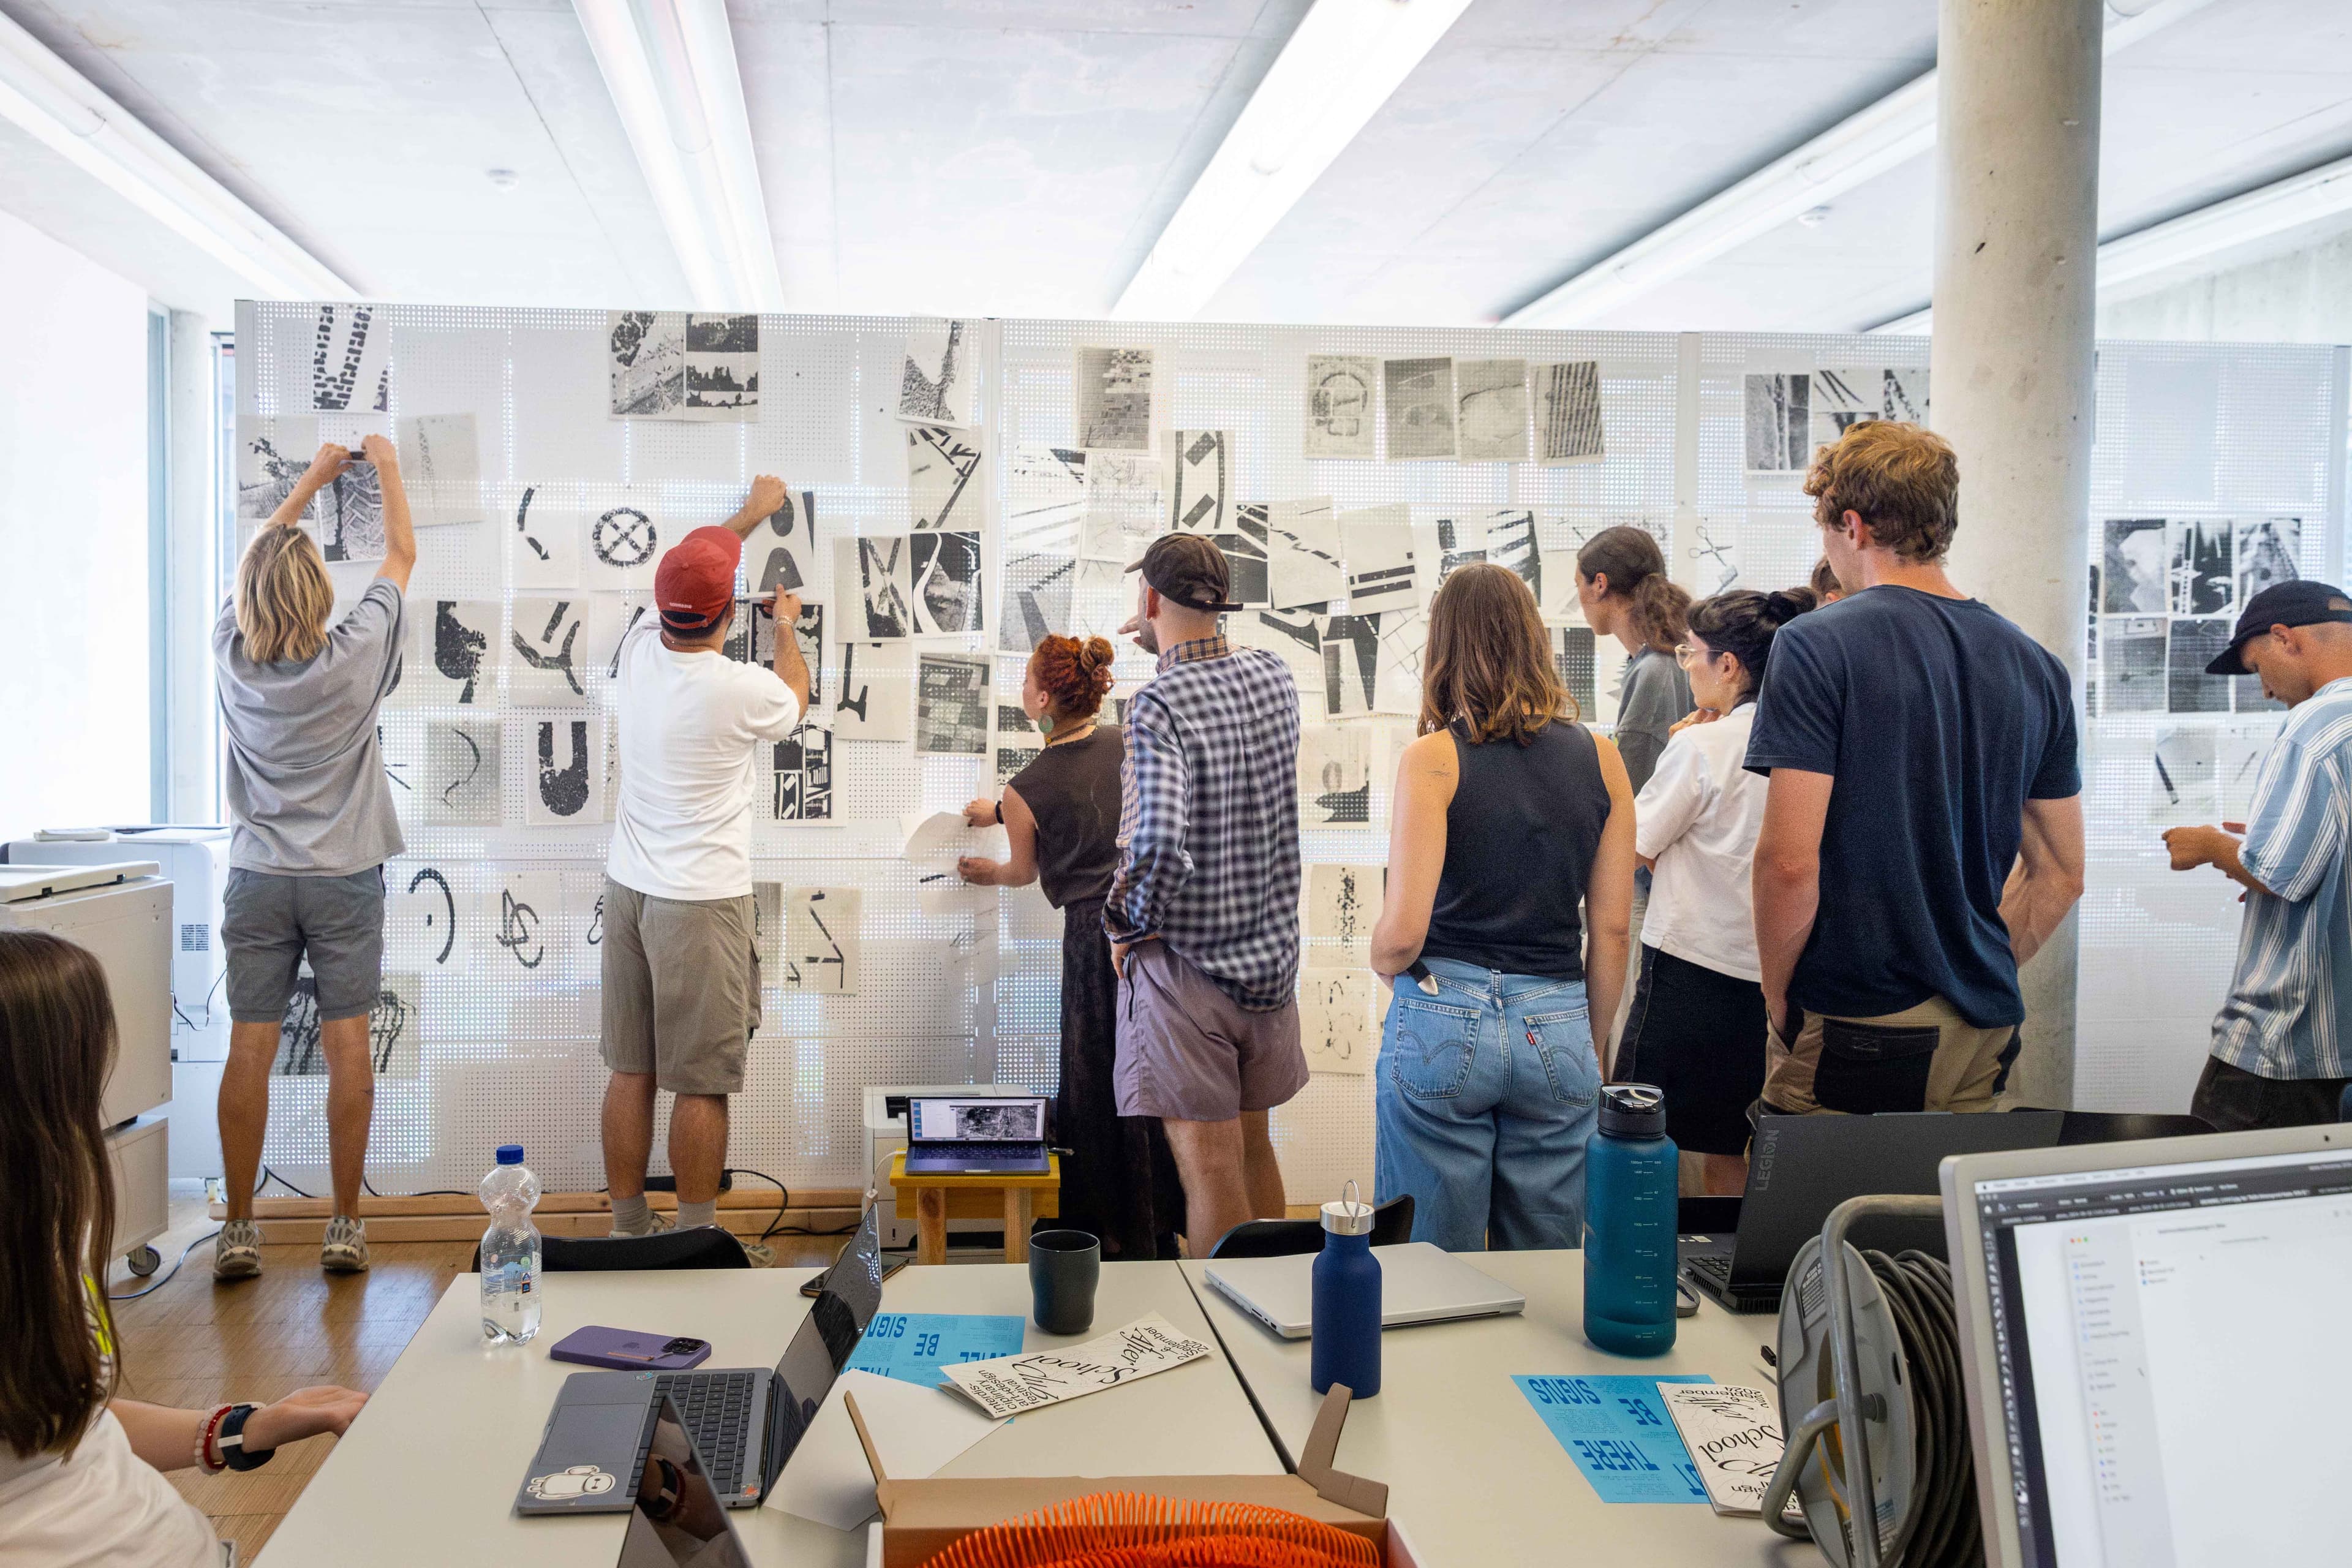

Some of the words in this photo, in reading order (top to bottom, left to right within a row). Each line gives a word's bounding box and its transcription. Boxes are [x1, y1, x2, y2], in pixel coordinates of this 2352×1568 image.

[1755, 1129, 1780, 1190] LEGION
[867, 1316, 907, 1338] SIGN
[913, 1333, 940, 1356] BE
[1120, 1326, 1164, 1366] After
[1144, 1326, 1199, 1356] September
[1180, 1339, 1209, 1352] 2024
[1019, 1355, 1139, 1384] School
[970, 1383, 1006, 1413] interdis-
[976, 1380, 1017, 1410] ciplinary
[1003, 1379, 1040, 1406] festival
[1528, 1379, 1601, 1405] SIGNS
[1680, 1389, 1764, 1402] September
[1724, 1386, 1761, 1395] 2024
[1618, 1398, 1663, 1425] BE
[1572, 1440, 1660, 1471] THERE
